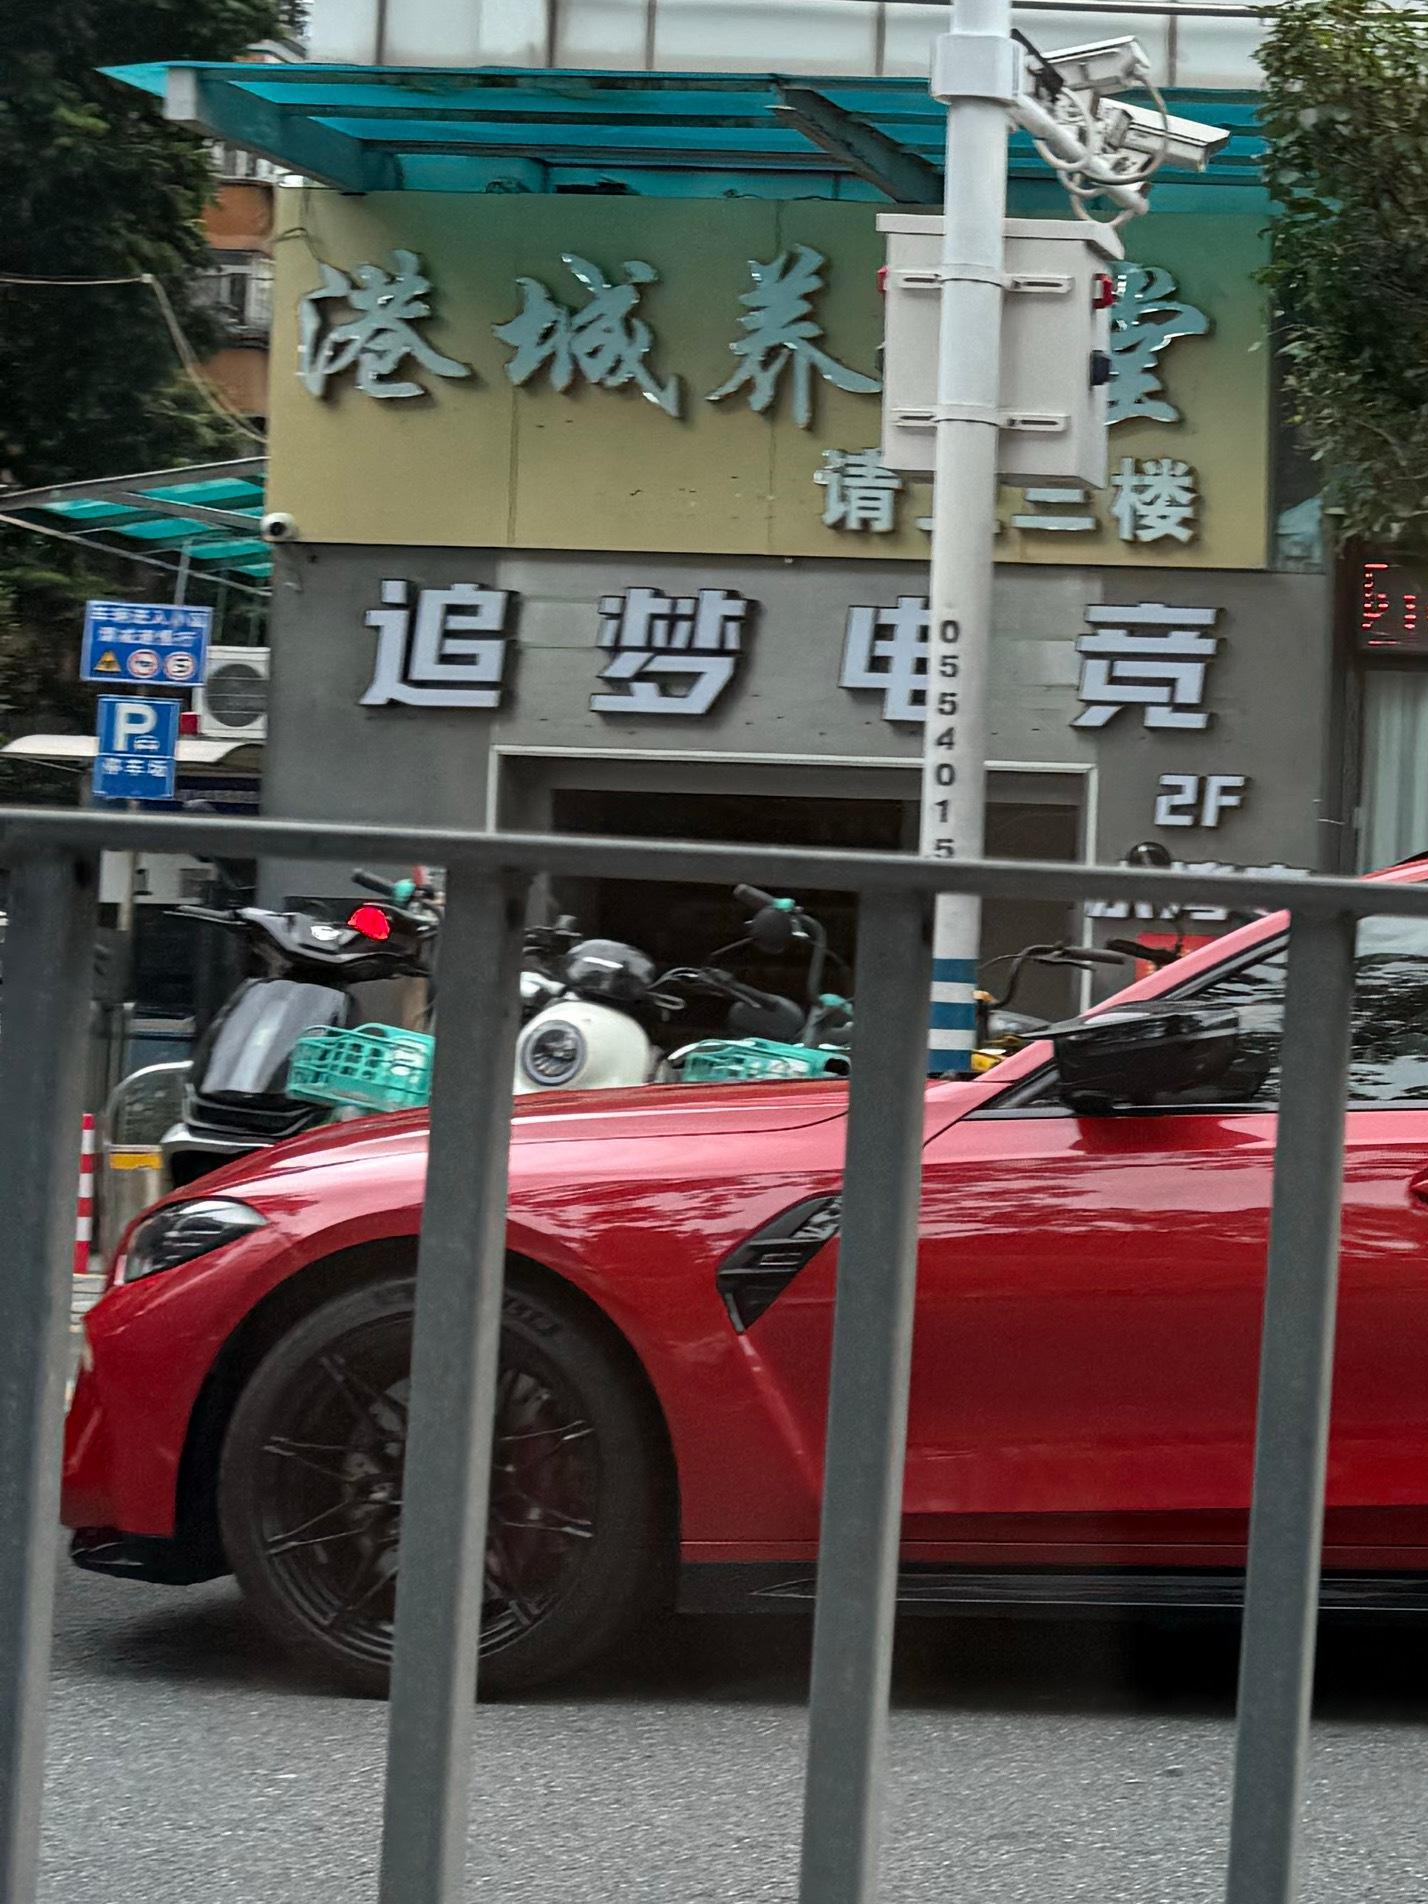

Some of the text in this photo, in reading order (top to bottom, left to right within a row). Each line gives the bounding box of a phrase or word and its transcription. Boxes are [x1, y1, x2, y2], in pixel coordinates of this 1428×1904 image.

[297, 245, 1208, 429] 港城养堂
[813, 447, 1198, 543] 请三楼
[111, 702, 159, 753] P
[1154, 774, 1246, 827] 2F
